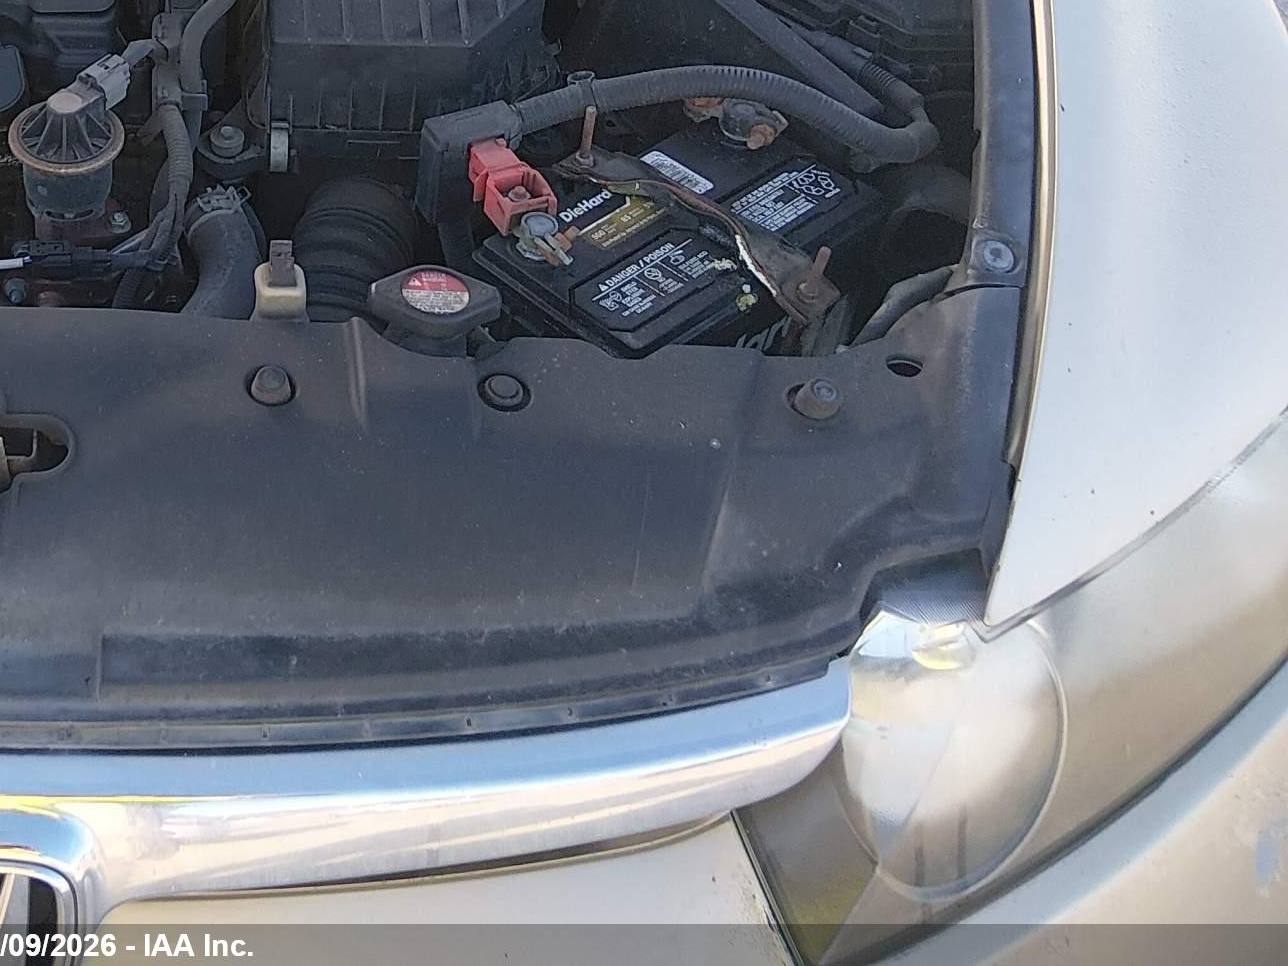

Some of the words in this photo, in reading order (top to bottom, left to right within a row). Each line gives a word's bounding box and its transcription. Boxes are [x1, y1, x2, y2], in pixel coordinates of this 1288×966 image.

[559, 188, 612, 223] DieHard
[605, 264, 640, 287] DANGER
[643, 242, 674, 263] POISON
